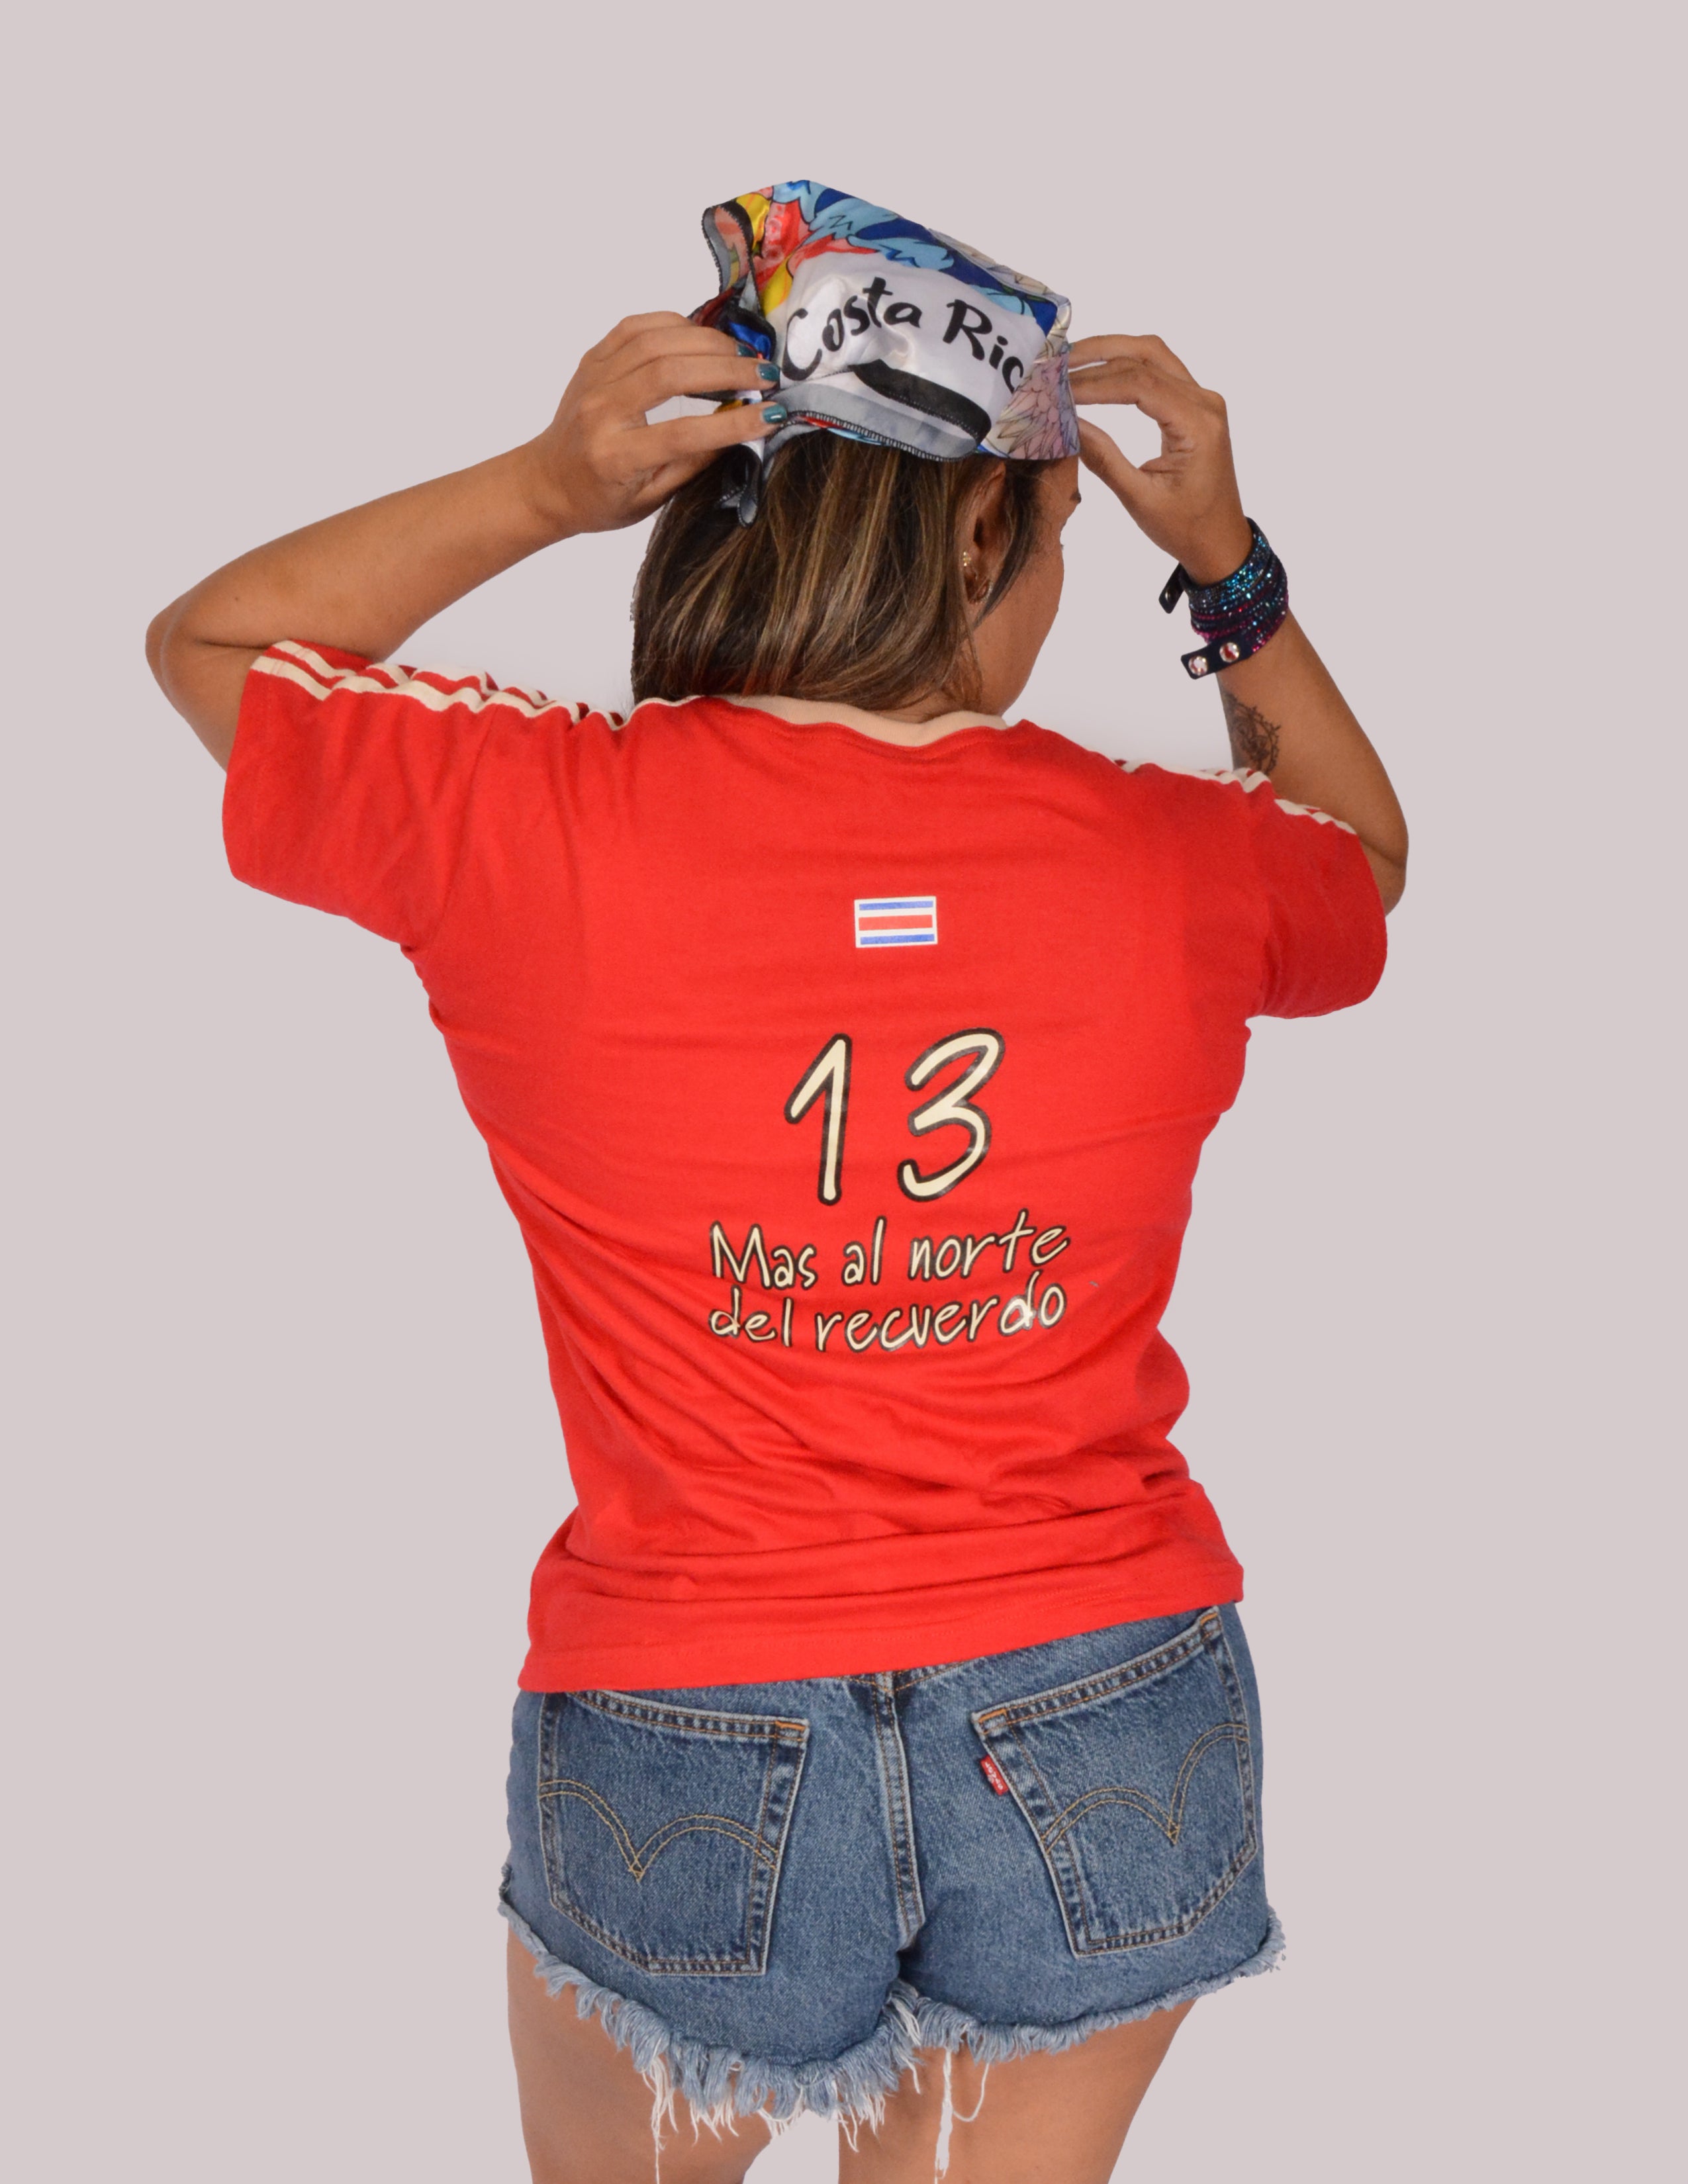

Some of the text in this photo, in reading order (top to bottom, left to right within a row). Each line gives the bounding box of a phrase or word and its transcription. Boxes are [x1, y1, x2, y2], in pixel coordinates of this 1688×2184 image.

[782, 277, 923, 381] Costa
[710, 1208, 1071, 1290] Mas al norte
[709, 1269, 1068, 1352] del recuerdo
